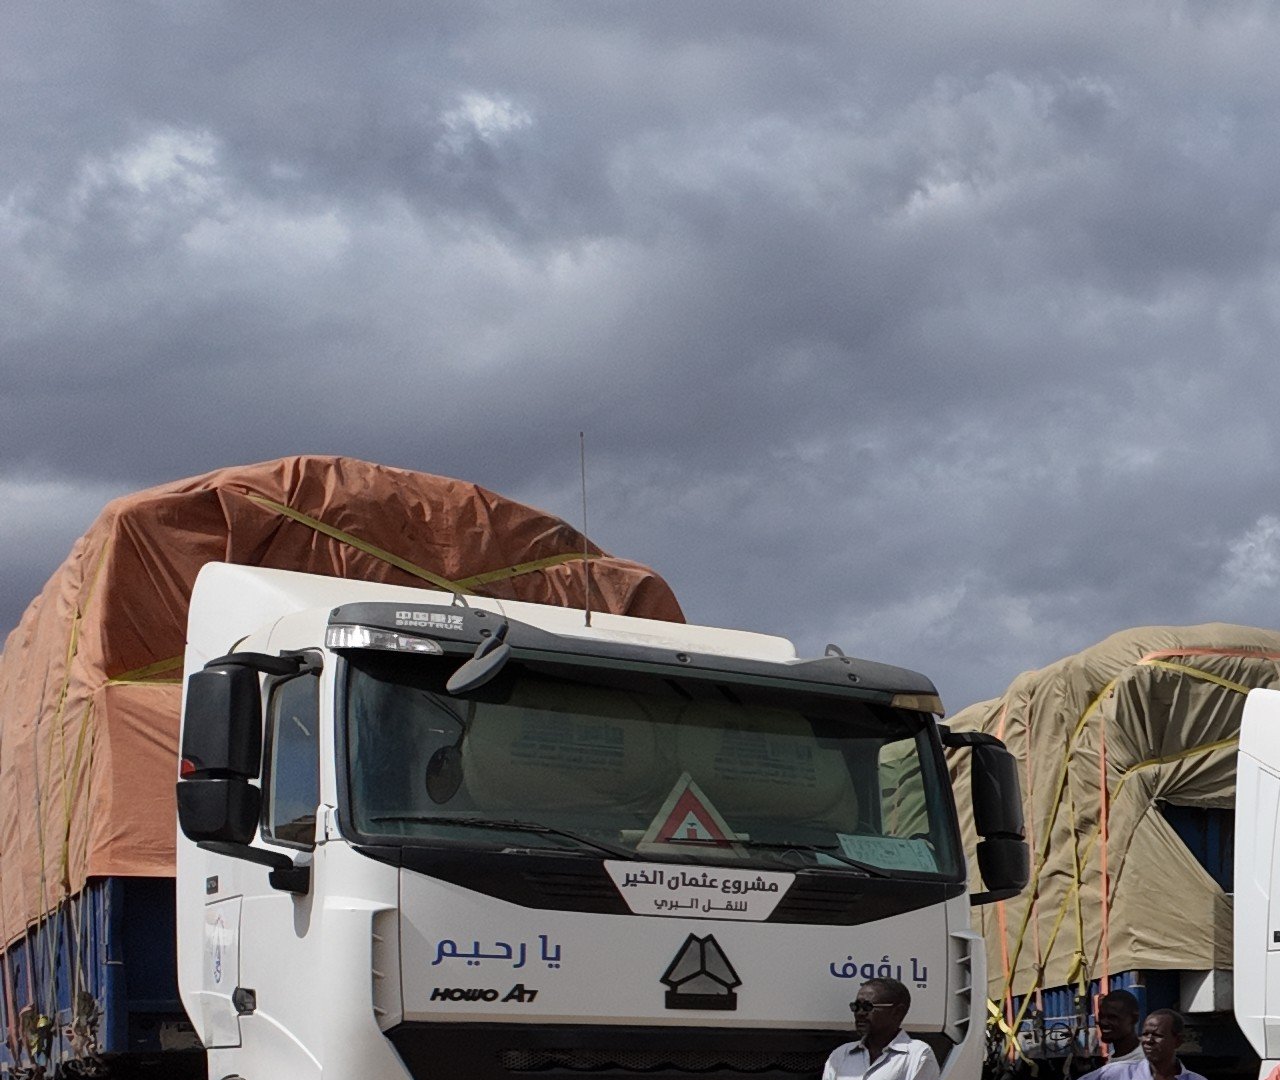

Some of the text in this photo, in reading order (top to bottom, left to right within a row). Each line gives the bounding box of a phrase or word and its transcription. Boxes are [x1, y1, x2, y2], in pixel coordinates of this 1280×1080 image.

[622, 870, 778, 894] مشروع عثمان الخير
[702, 899, 747, 912] للنقل
[432, 934, 560, 969] يا رحيم
[910, 958, 927, 988] يا
[430, 984, 538, 1002] HOWO A7
